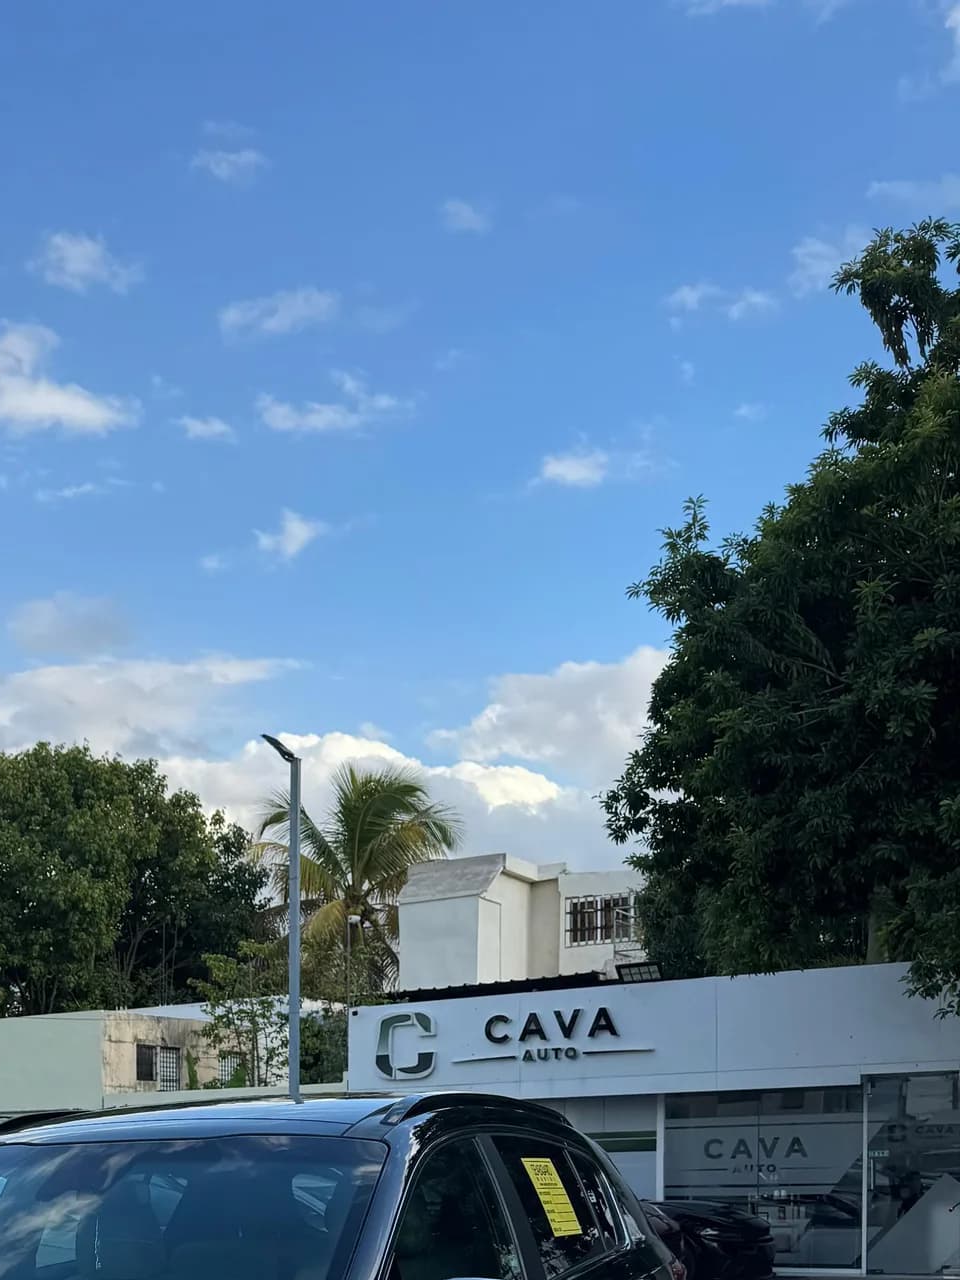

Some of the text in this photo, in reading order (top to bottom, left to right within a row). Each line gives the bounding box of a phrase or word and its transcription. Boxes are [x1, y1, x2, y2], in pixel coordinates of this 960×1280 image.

[484, 1007, 620, 1044] CAVA
[522, 1047, 579, 1063] AUTO
[703, 1136, 808, 1160] CAVA
